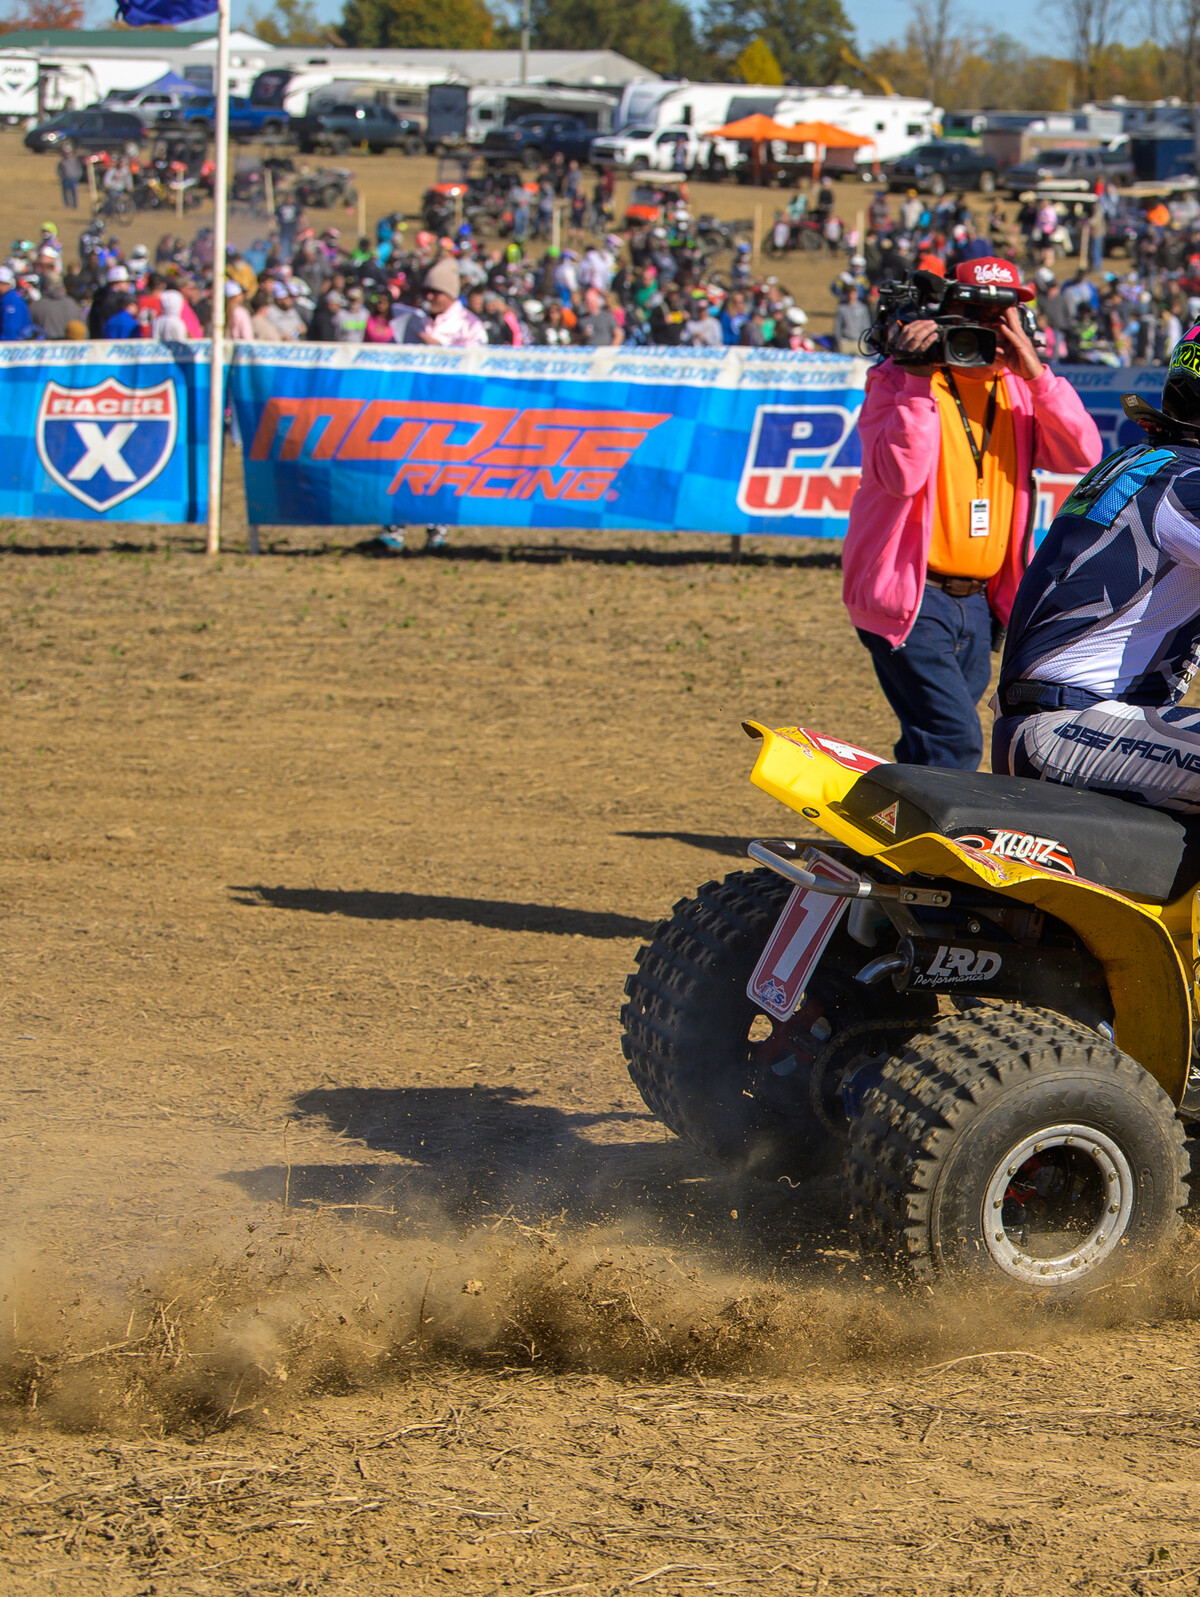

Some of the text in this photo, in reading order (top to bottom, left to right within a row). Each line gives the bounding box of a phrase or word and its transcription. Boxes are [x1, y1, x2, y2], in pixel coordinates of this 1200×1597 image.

[0, 344, 91, 361] ROGRESSIVE
[51, 397, 165, 415] RACER
[250, 397, 674, 468] MOOSE
[66, 422, 138, 483] X
[386, 463, 619, 502] RACING
[990, 831, 1060, 862] KLOTZ
[772, 884, 843, 982] 1
[914, 970, 986, 986] Performance
[926, 945, 1003, 980] LRD
